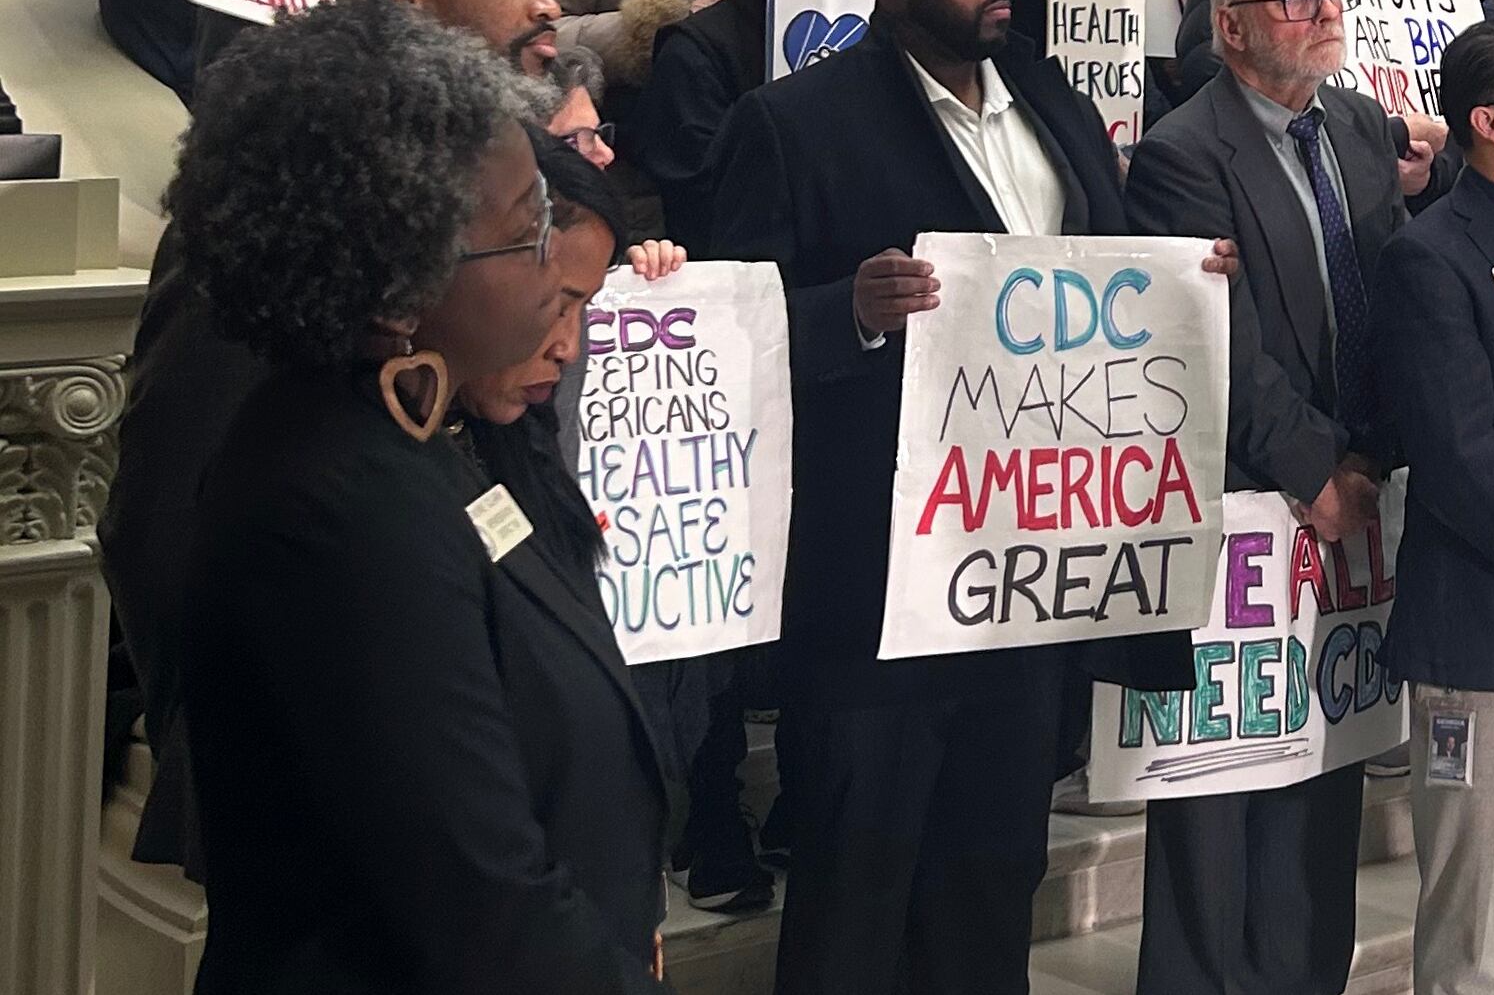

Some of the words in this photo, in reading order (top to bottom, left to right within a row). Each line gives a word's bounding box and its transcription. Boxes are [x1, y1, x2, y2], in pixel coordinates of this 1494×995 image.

[1053, 2, 1139, 46] HEALTH
[1355, 15, 1402, 65] ARE
[1359, 62, 1418, 117] YOUR
[586, 308, 697, 354] CDC
[996, 267, 1153, 355] CDC
[580, 392, 730, 442] ERICANS
[939, 355, 1189, 442] MAKES
[577, 428, 758, 502] HEALTHY
[915, 438, 1202, 535] AMERICA
[614, 498, 728, 567] SAFE
[600, 553, 756, 632] DUCTIVE
[948, 536, 1193, 626] GREAT
[1220, 531, 1275, 629] E
[1289, 516, 1395, 621] ALL
[1118, 635, 1310, 749] NEED
